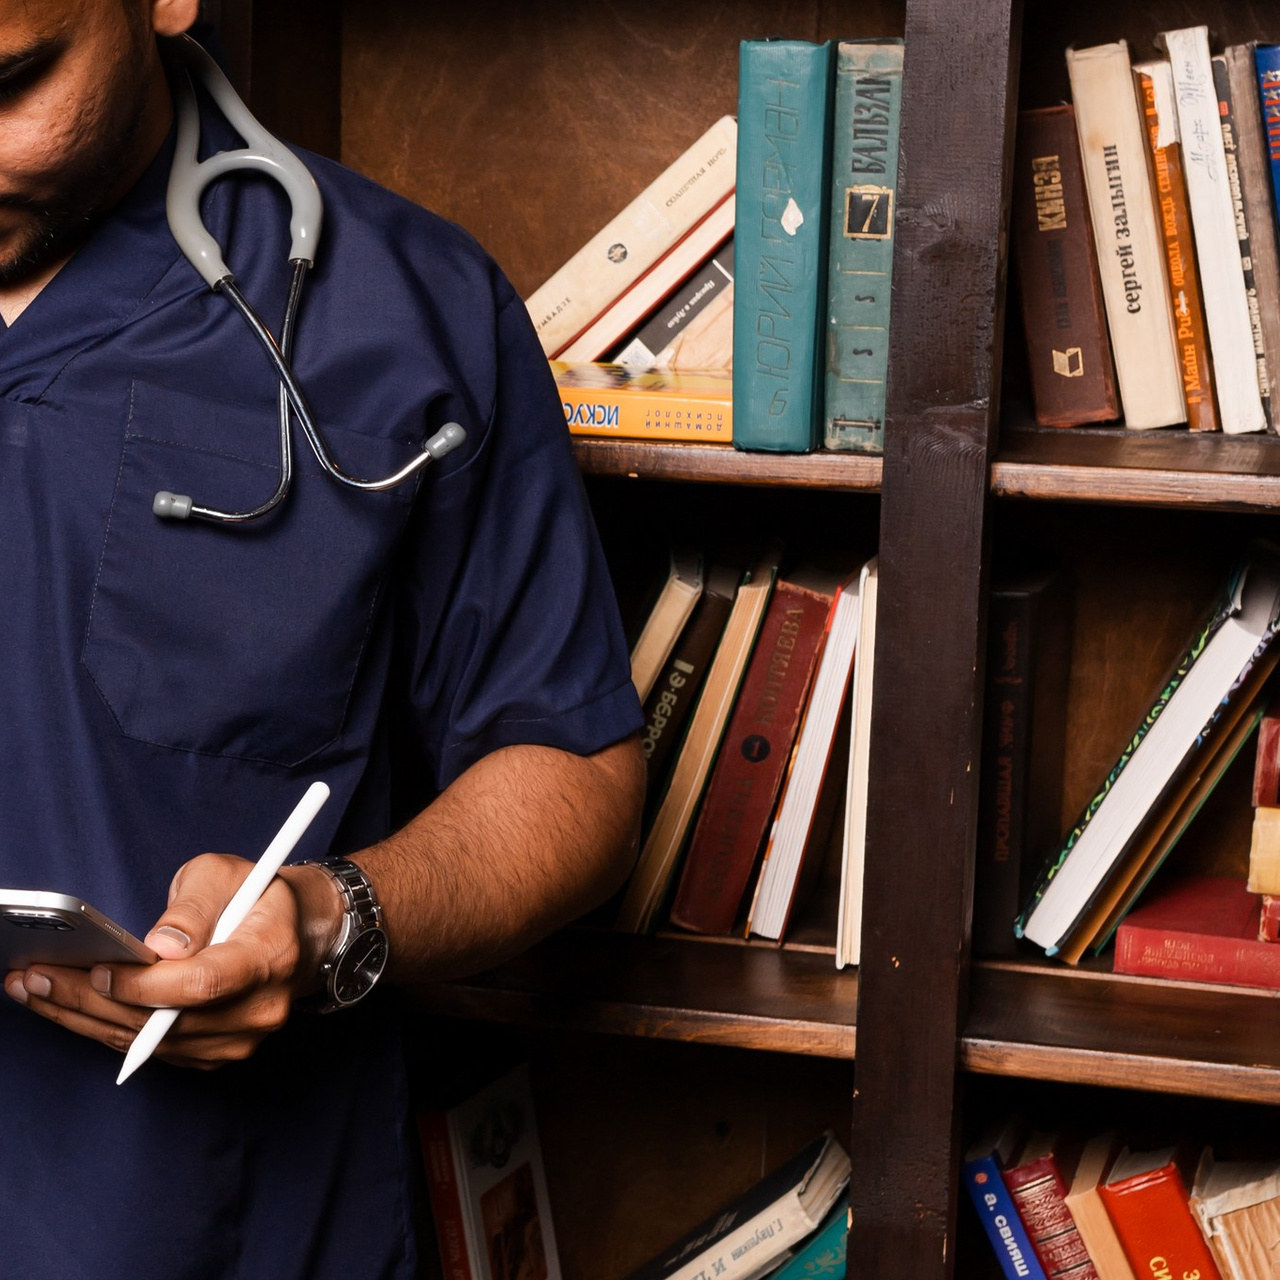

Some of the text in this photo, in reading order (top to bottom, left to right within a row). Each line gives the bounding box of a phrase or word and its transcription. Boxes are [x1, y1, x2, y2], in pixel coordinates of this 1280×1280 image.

[860, 194, 880, 233] 7
[1032, 155, 1067, 232] КИНЗЯ
[536, 147, 728, 332] УМБАДЗЕ СОЛНЕЧНАЯ НОЧЬ
[1103, 144, 1143, 315] сергей залыгин
[1161, 199, 1180, 241] ВОЖДЬ
[755, 255, 794, 380] ЮРИЙ
[1183, 342, 1202, 394] Майн
[562, 402, 620, 429] ИСКУС
[645, 409, 723, 421] ПСИХОЛОГ
[750, 741, 761, 757] 1
[711, 1257, 727, 1277] И
